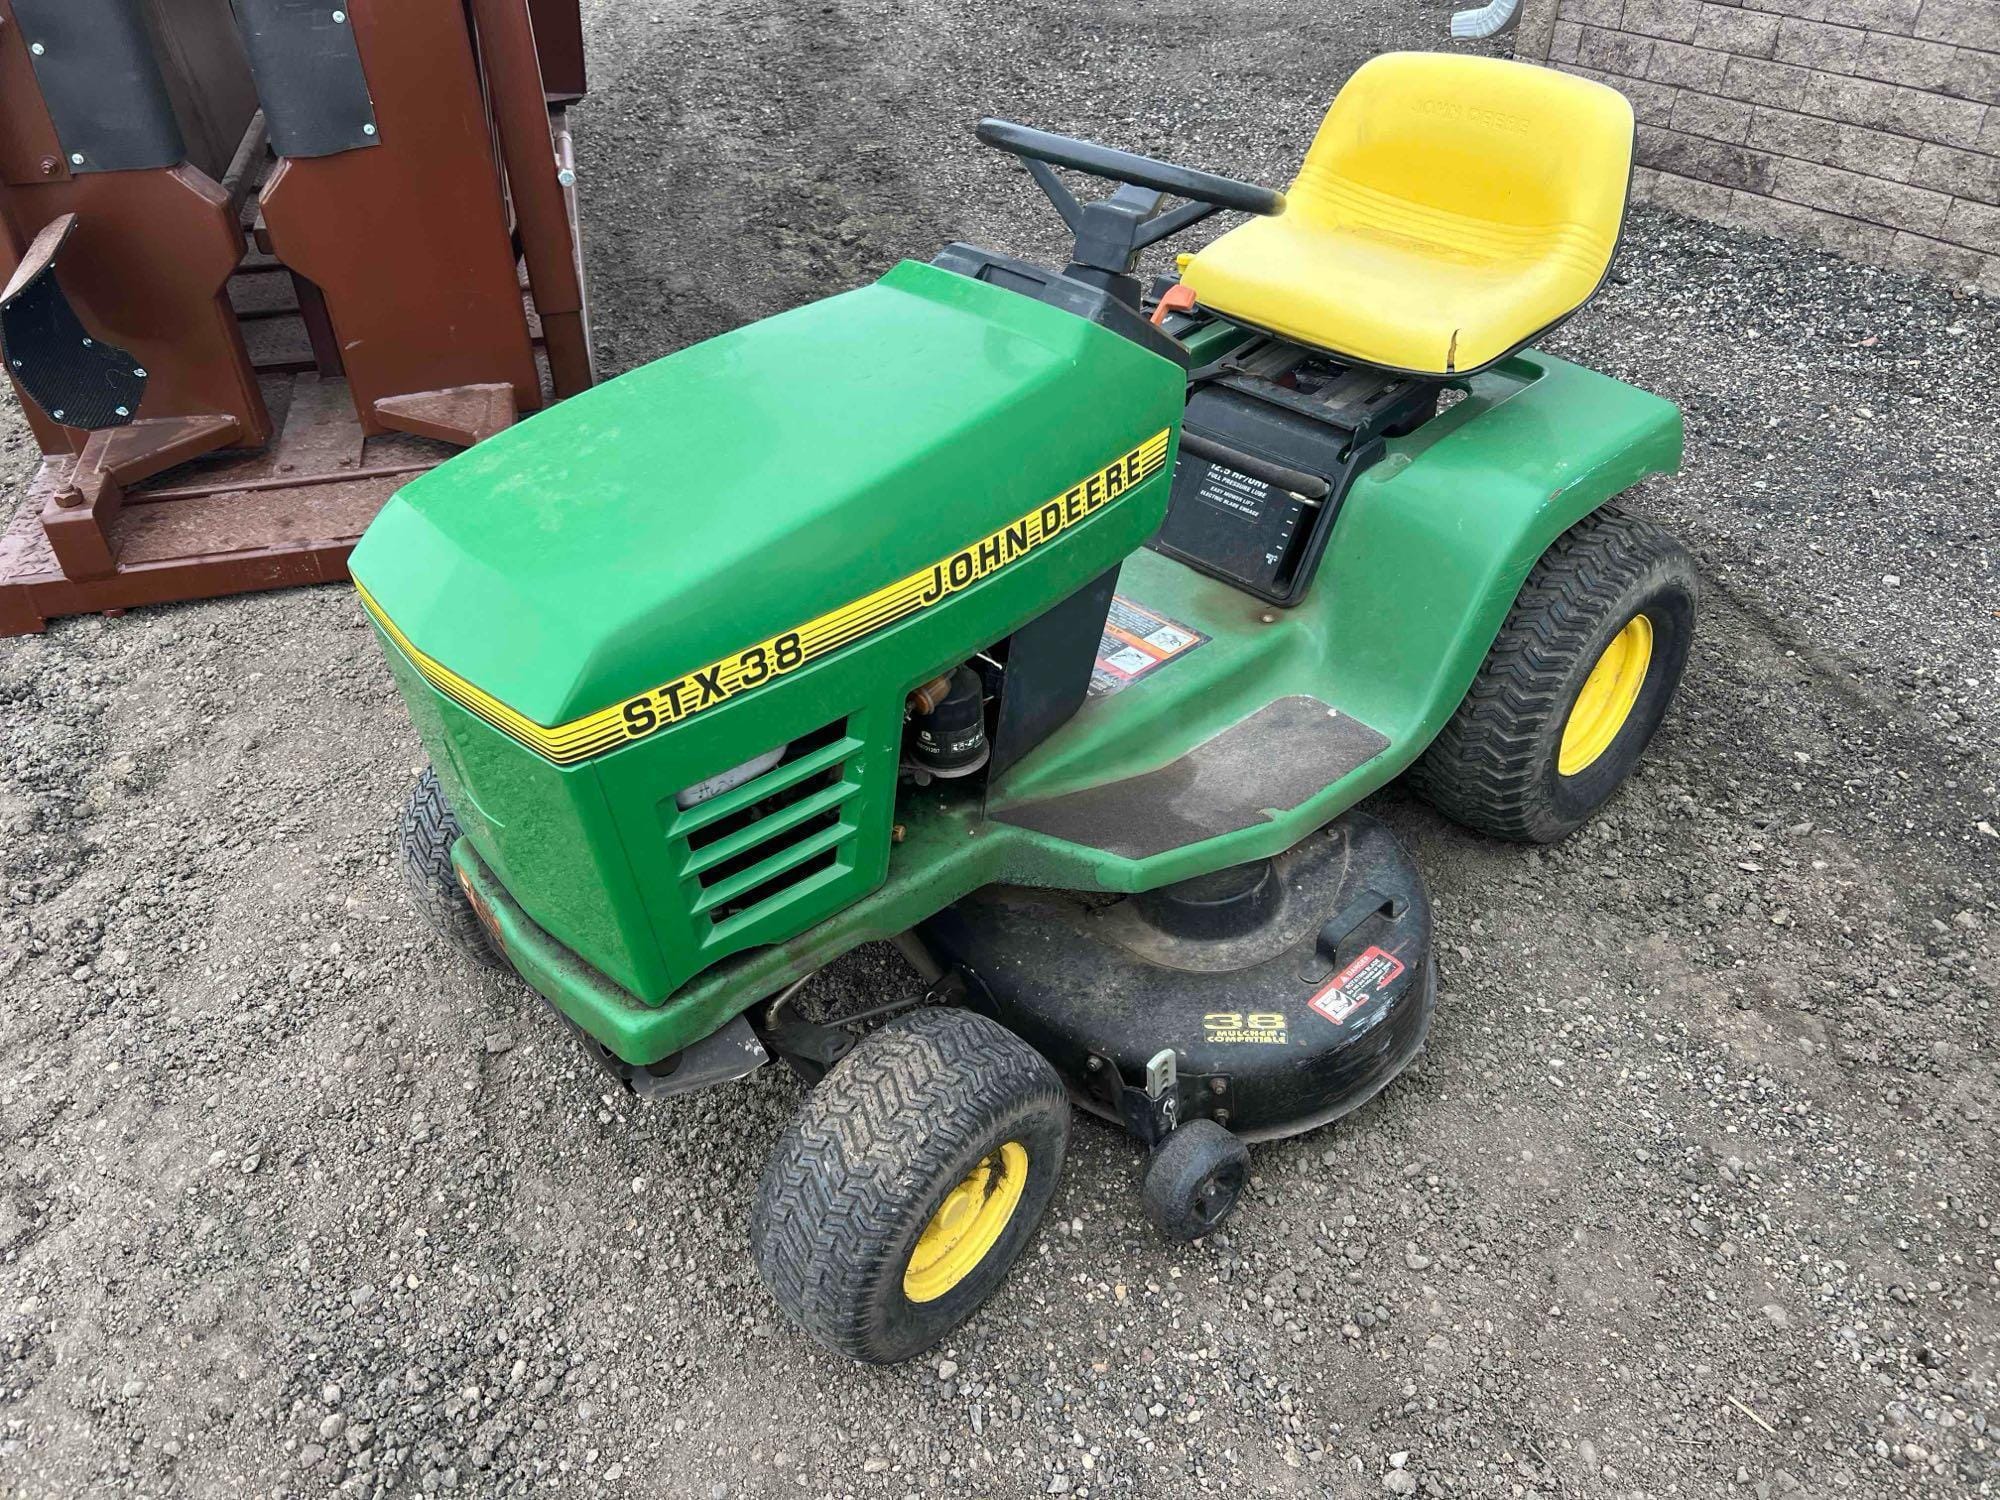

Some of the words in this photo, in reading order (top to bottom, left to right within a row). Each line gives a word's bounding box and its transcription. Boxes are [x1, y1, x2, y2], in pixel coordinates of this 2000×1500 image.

[1470, 105, 1530, 136] DEERE
[1200, 489, 1223, 503] ELECTRIC
[1207, 471, 1221, 482] FULL
[1221, 476, 1252, 493] PRESSURE
[1251, 487, 1268, 500] LUBE
[1209, 485, 1224, 495] EASY
[1243, 499, 1255, 507] LIFT
[923, 520, 1029, 604] JOHN
[1041, 450, 1142, 540] DEERE
[622, 664, 728, 736] STX
[740, 632, 803, 686] 38
[1203, 1013, 1287, 1031] 38
